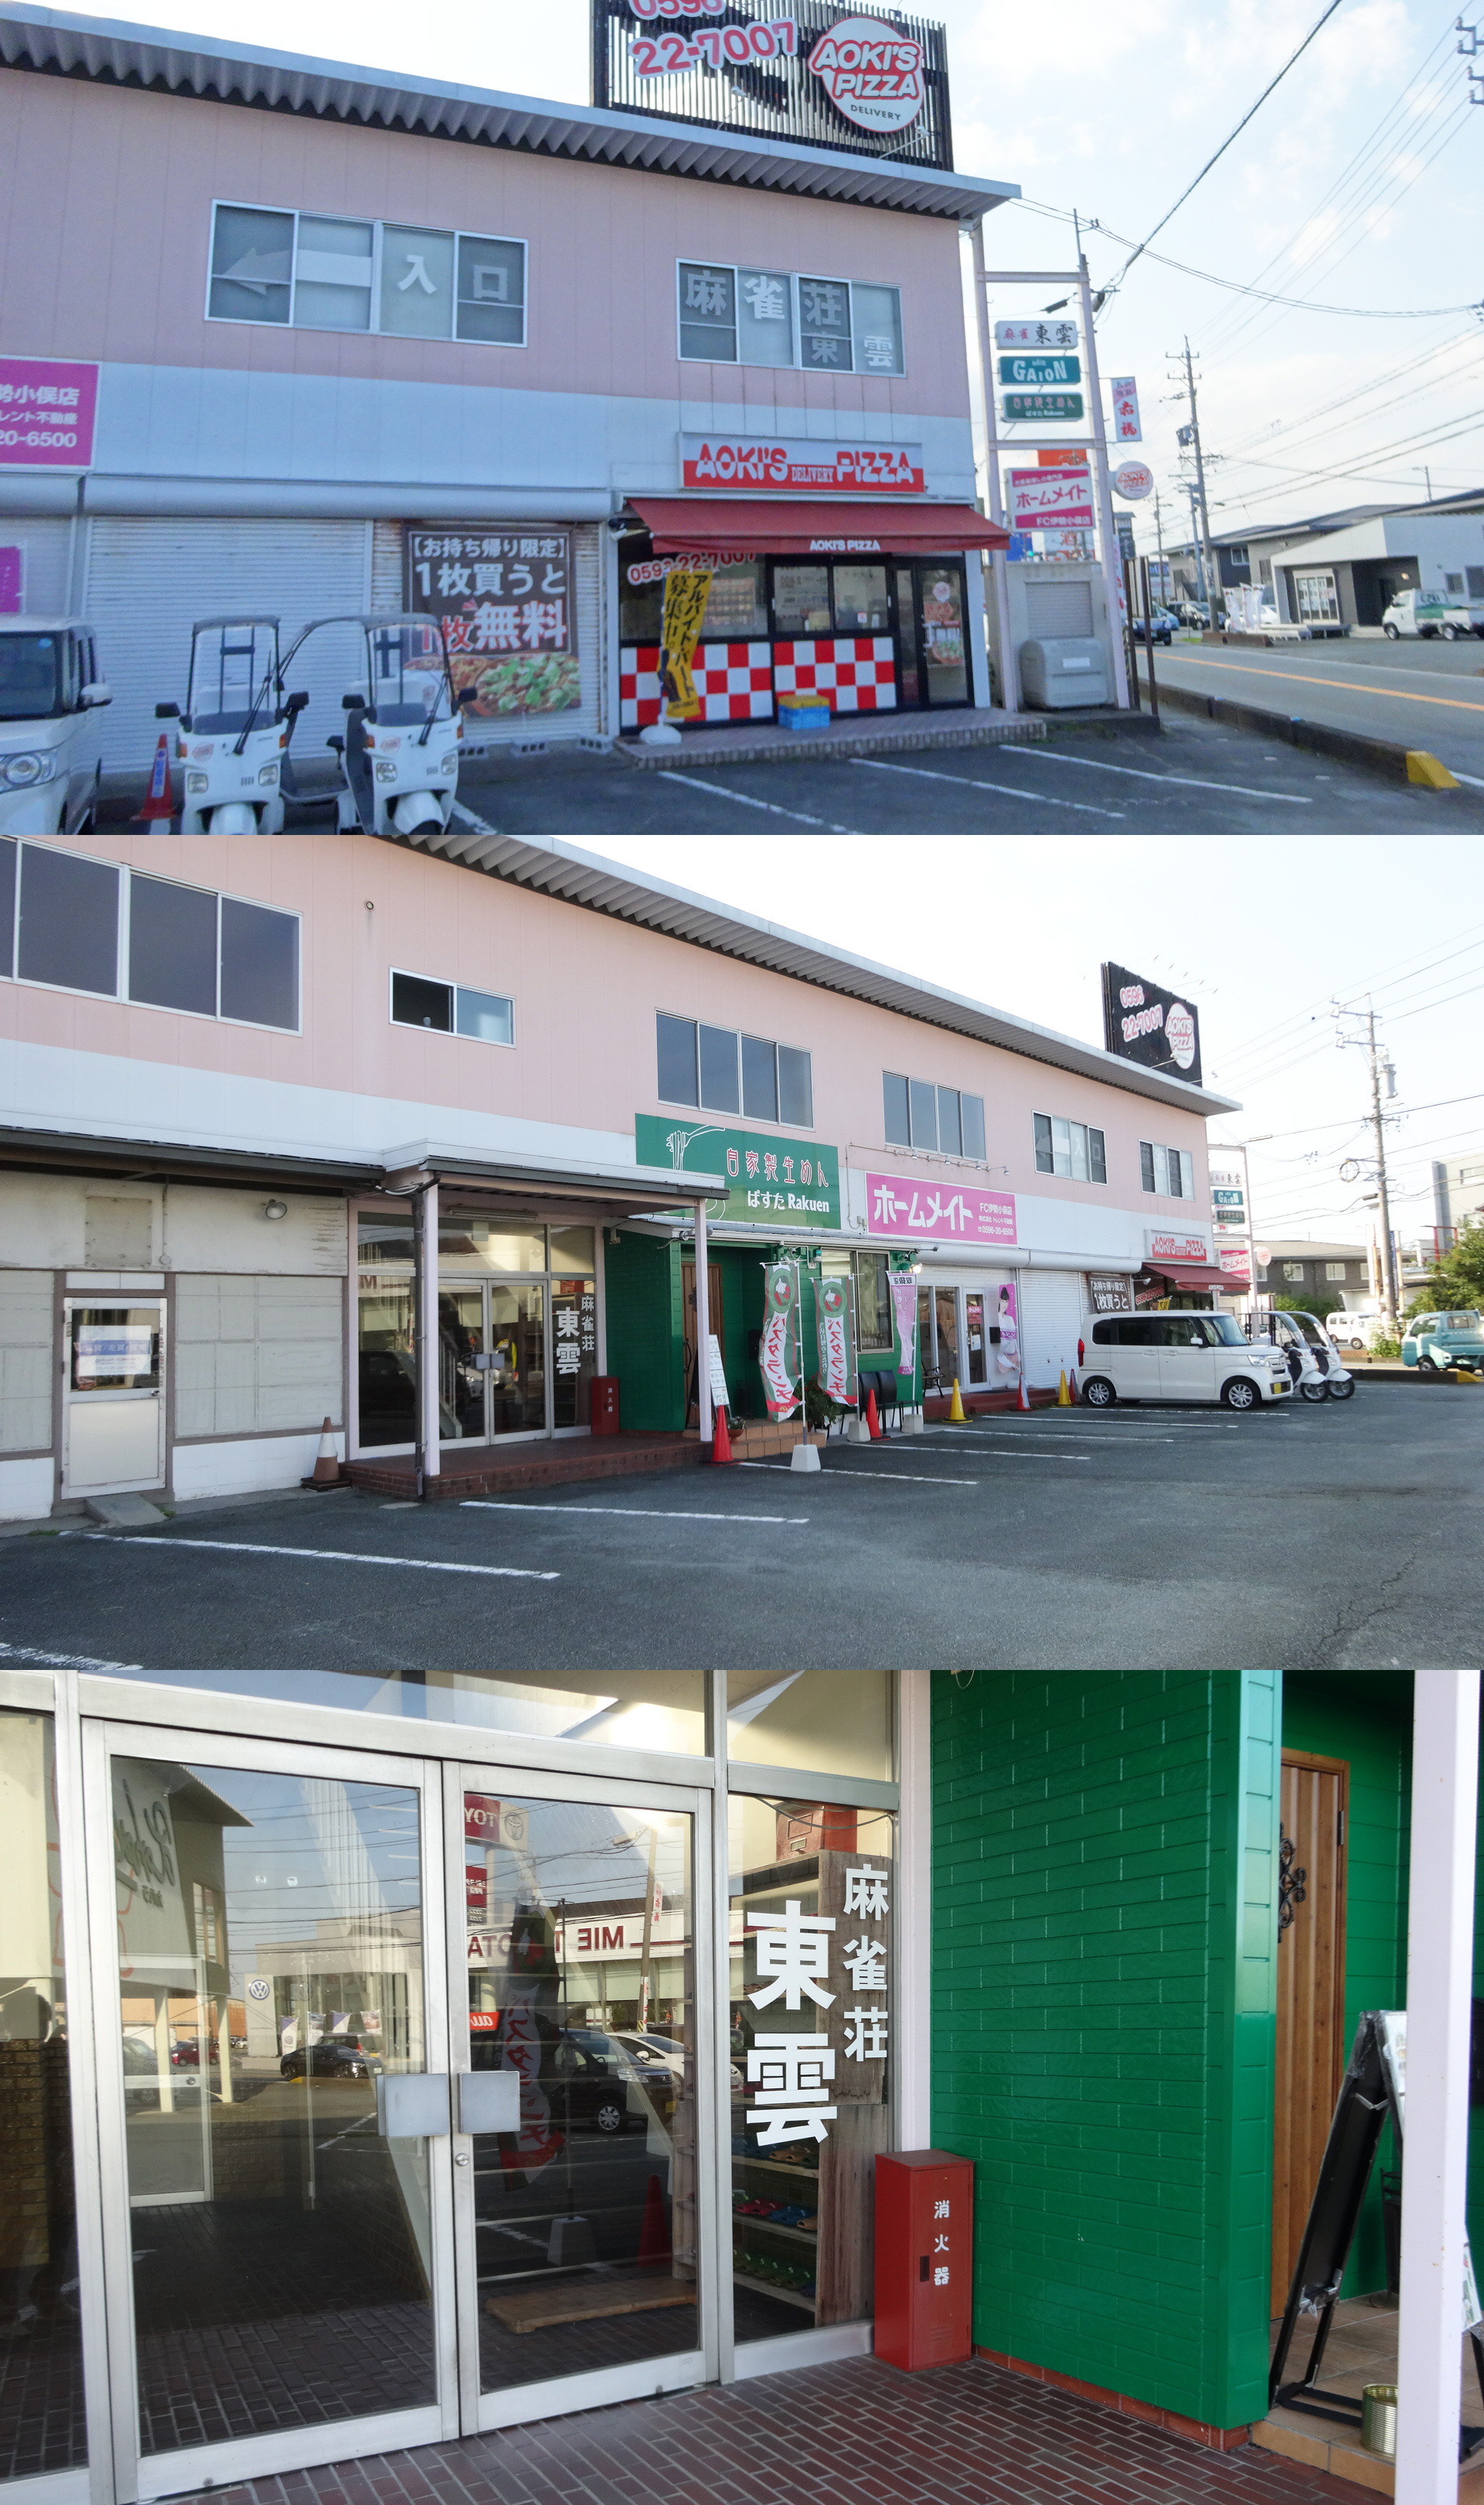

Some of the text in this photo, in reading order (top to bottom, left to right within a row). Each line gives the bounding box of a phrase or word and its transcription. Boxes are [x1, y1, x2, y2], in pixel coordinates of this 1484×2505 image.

[631, 19, 797, 77] 22-7007
[815, 42, 920, 71] AOKI'S
[835, 73, 920, 97] PIZZA
[850, 104, 901, 121] DELIVERY
[397, 254, 509, 302] 入口
[686, 271, 842, 326] 麻雀荘
[811, 332, 893, 367] 東雲
[1034, 322, 1074, 345] 東雲
[696, 443, 914, 484] AOKI'S DELIVERY PIZZA
[1016, 484, 1087, 509] ホームメイト
[810, 540, 881, 551] AOKI'S PIZZA
[416, 561, 567, 597] 1枚買うと
[1121, 987, 1144, 1007] 0596
[1123, 1006, 1162, 1041] 22-7007
[727, 1147, 829, 1188] 自家製生めん
[747, 1189, 830, 1213] ぱすた Rakuen
[873, 1184, 974, 1232] ホームメイト
[1154, 1236, 1176, 1256] AOKI'S
[1186, 1239, 1205, 1257] PIZZA
[556, 1307, 581, 1375] 東雲
[581, 1295, 595, 1352] 麻雀荘
[842, 1863, 890, 2062] 麻雀荘
[746, 1900, 838, 2146] 東雲
[933, 2200, 951, 2286] 消火器
